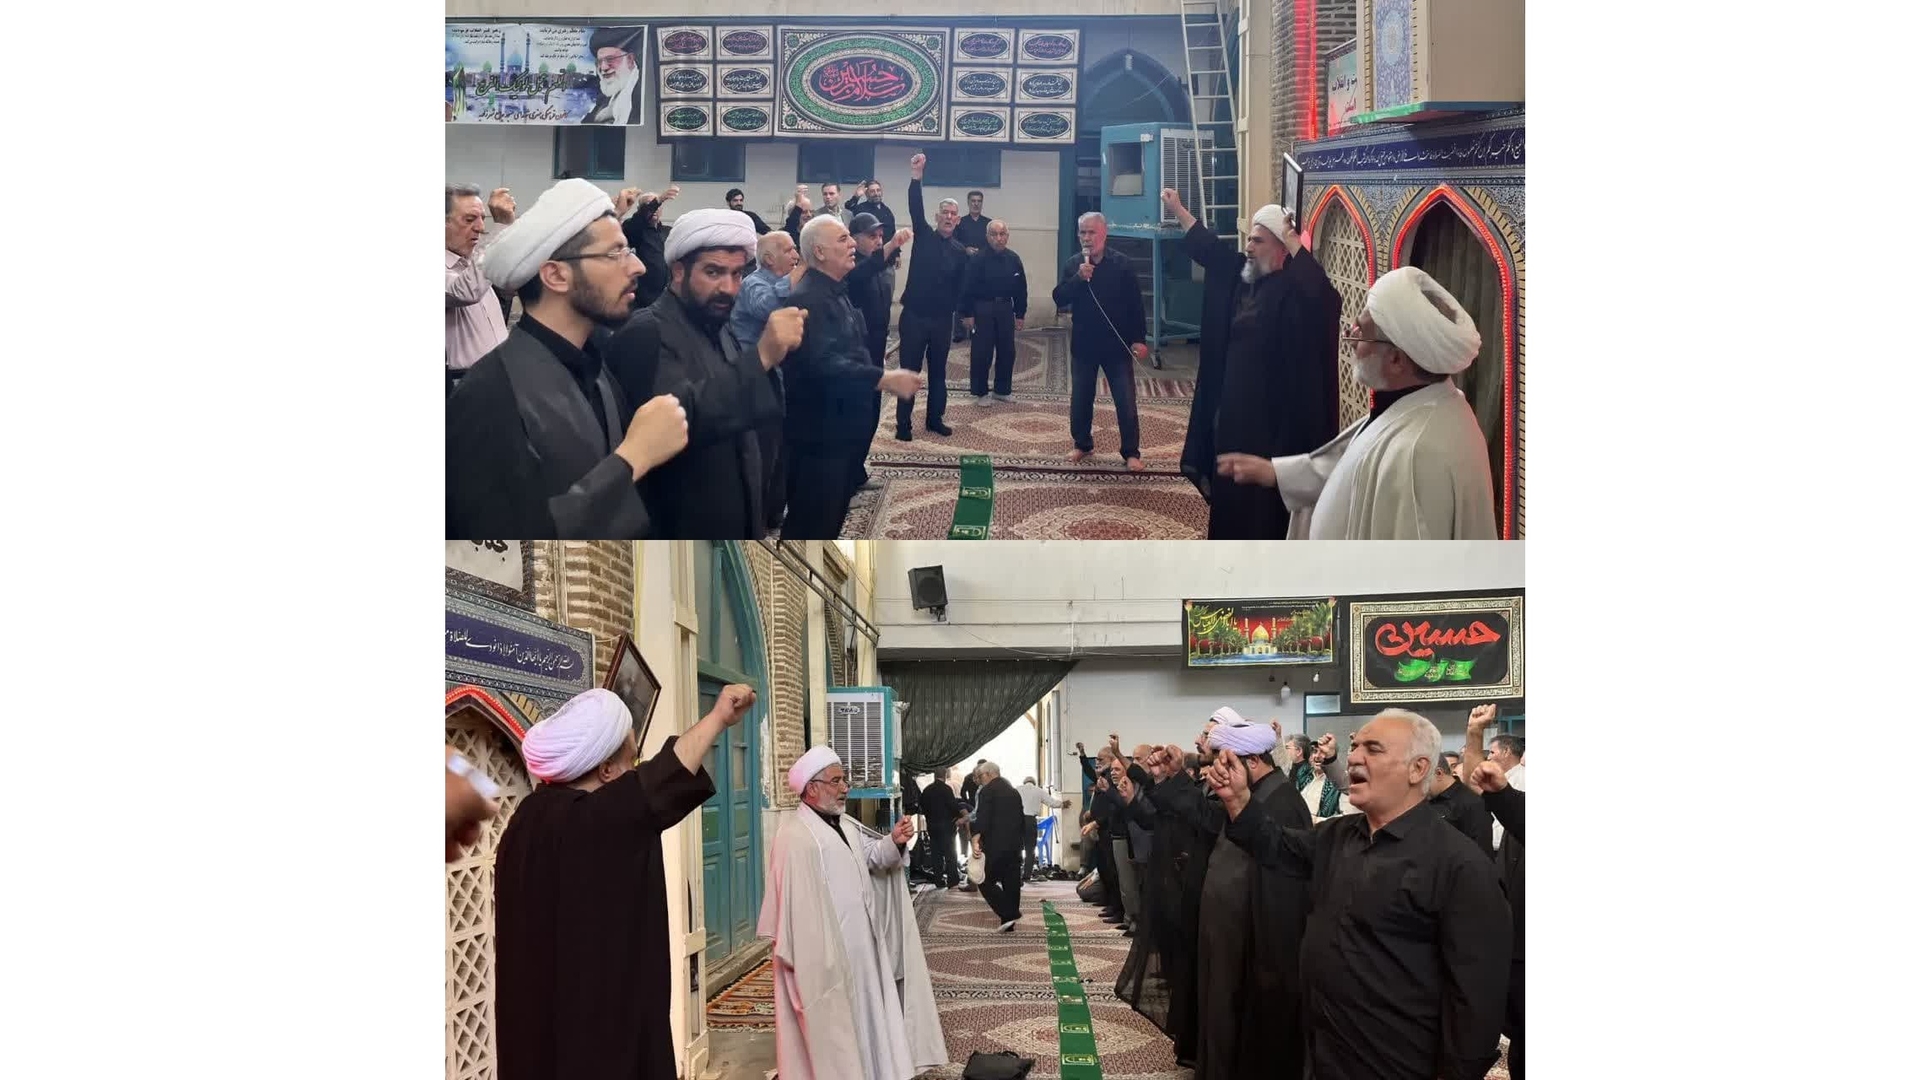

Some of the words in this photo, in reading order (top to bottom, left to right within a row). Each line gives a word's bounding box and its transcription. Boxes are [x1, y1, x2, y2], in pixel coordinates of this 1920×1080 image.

[475, 74, 500, 96] الفرج
[498, 65, 530, 100] لولیک
[527, 72, 547, 96] عجل
[544, 68, 568, 105] اللهم
[819, 62, 900, 92] حسین
[1375, 620, 1501, 657] حسین
